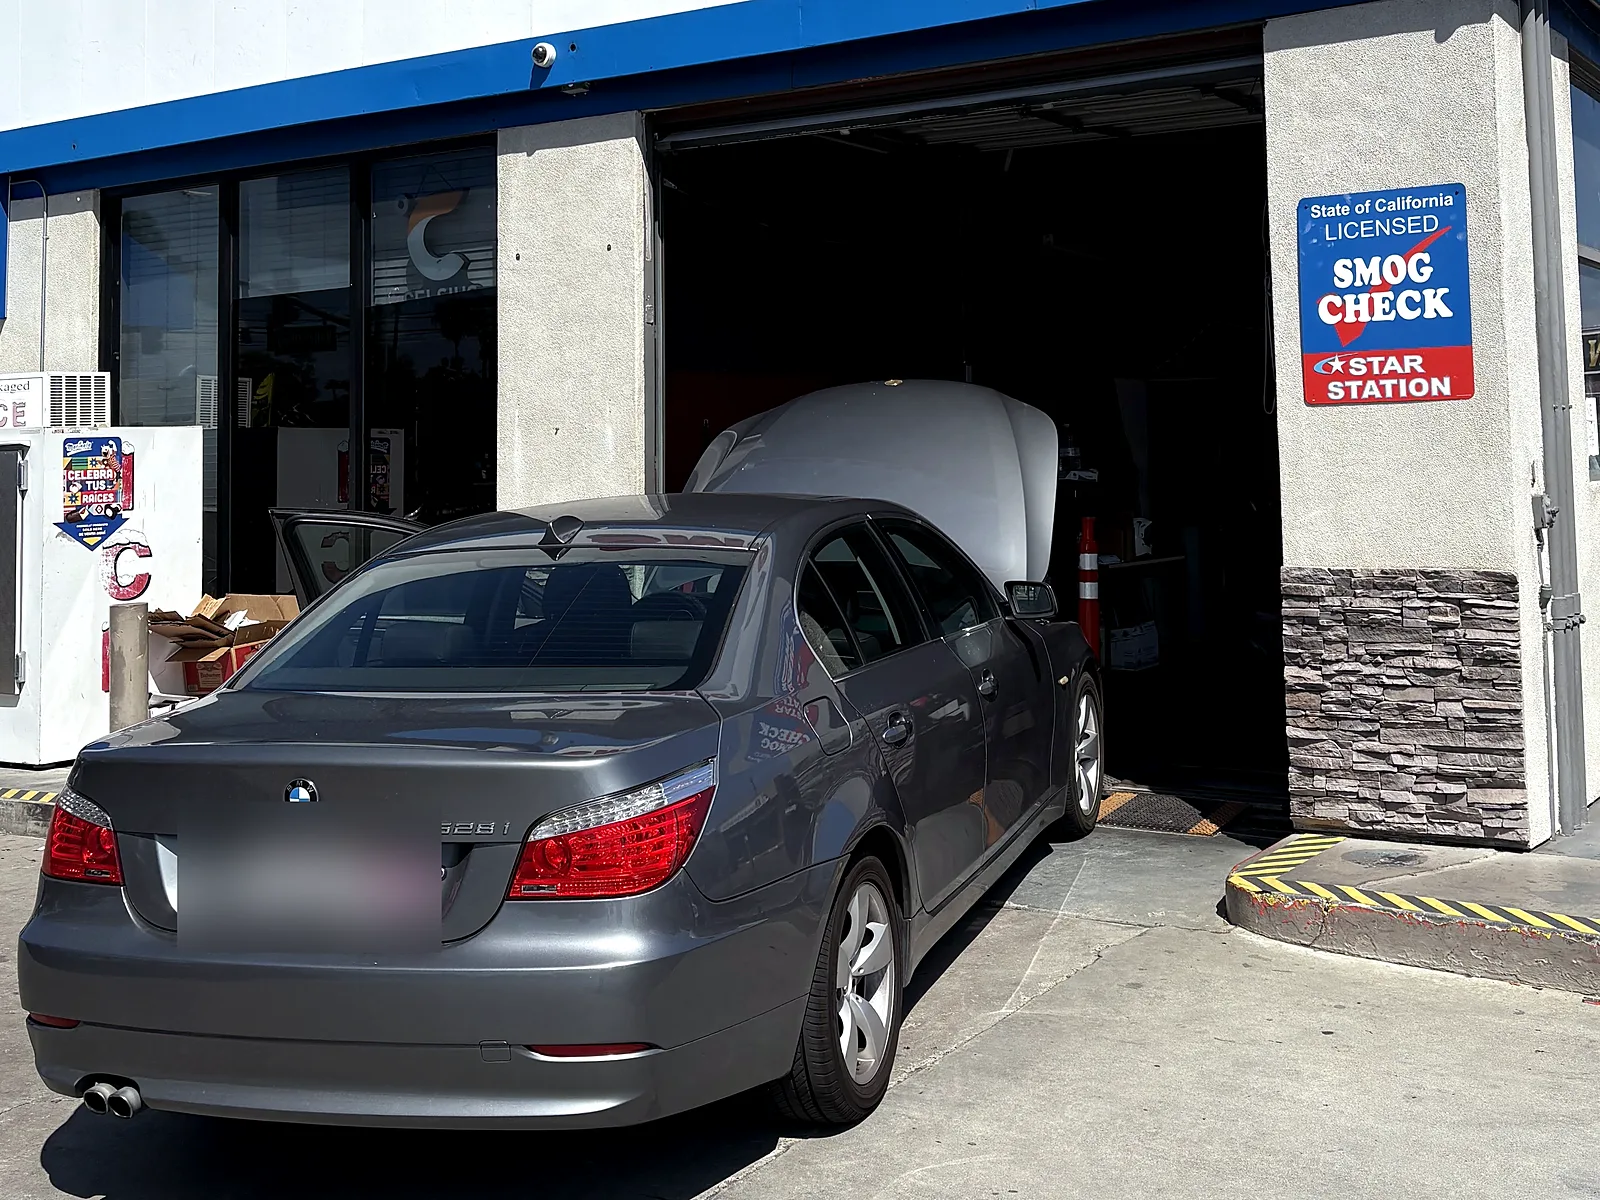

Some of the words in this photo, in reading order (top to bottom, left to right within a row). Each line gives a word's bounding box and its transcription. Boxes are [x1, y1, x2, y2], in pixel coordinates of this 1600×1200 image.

[1310, 203, 1350, 219] State
[1355, 200, 1371, 215] of
[1375, 193, 1454, 213] California
[1325, 215, 1438, 241] LICENSED
[1333, 252, 1433, 288] SMOG
[1317, 287, 1454, 325] CHECK
[1348, 355, 1426, 376] STAR
[1327, 376, 1452, 400] STATION
[67, 469, 114, 480] CELEBRA
[85, 480, 106, 491] TUS
